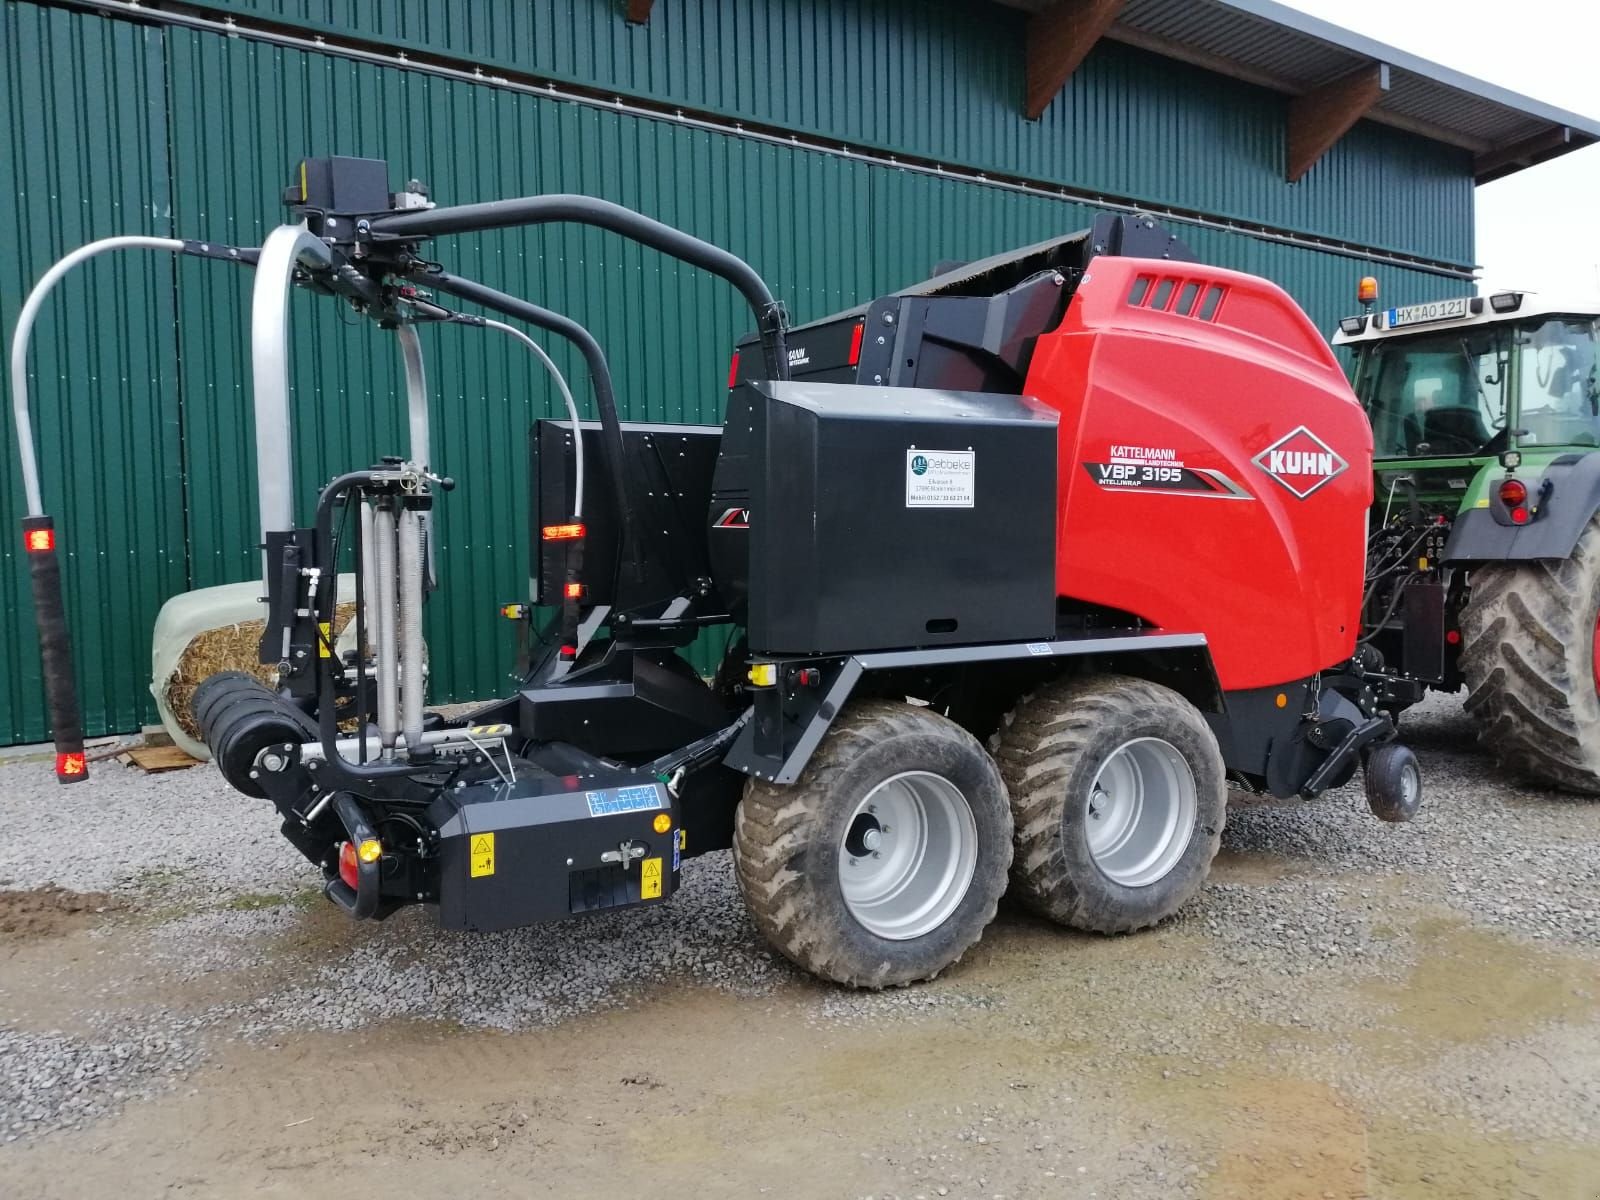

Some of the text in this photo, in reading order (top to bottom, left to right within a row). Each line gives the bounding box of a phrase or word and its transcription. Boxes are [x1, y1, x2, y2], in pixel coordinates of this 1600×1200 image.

[1397, 300, 1463, 322] HX AO 121
[1110, 445, 1176, 460] KATTELMANN
[1144, 459, 1185, 468] LANDTECHNIK
[1270, 450, 1333, 476] KUHN
[1099, 464, 1182, 482] VBP 3195
[1098, 479, 1142, 487] INTELLIWRAP
